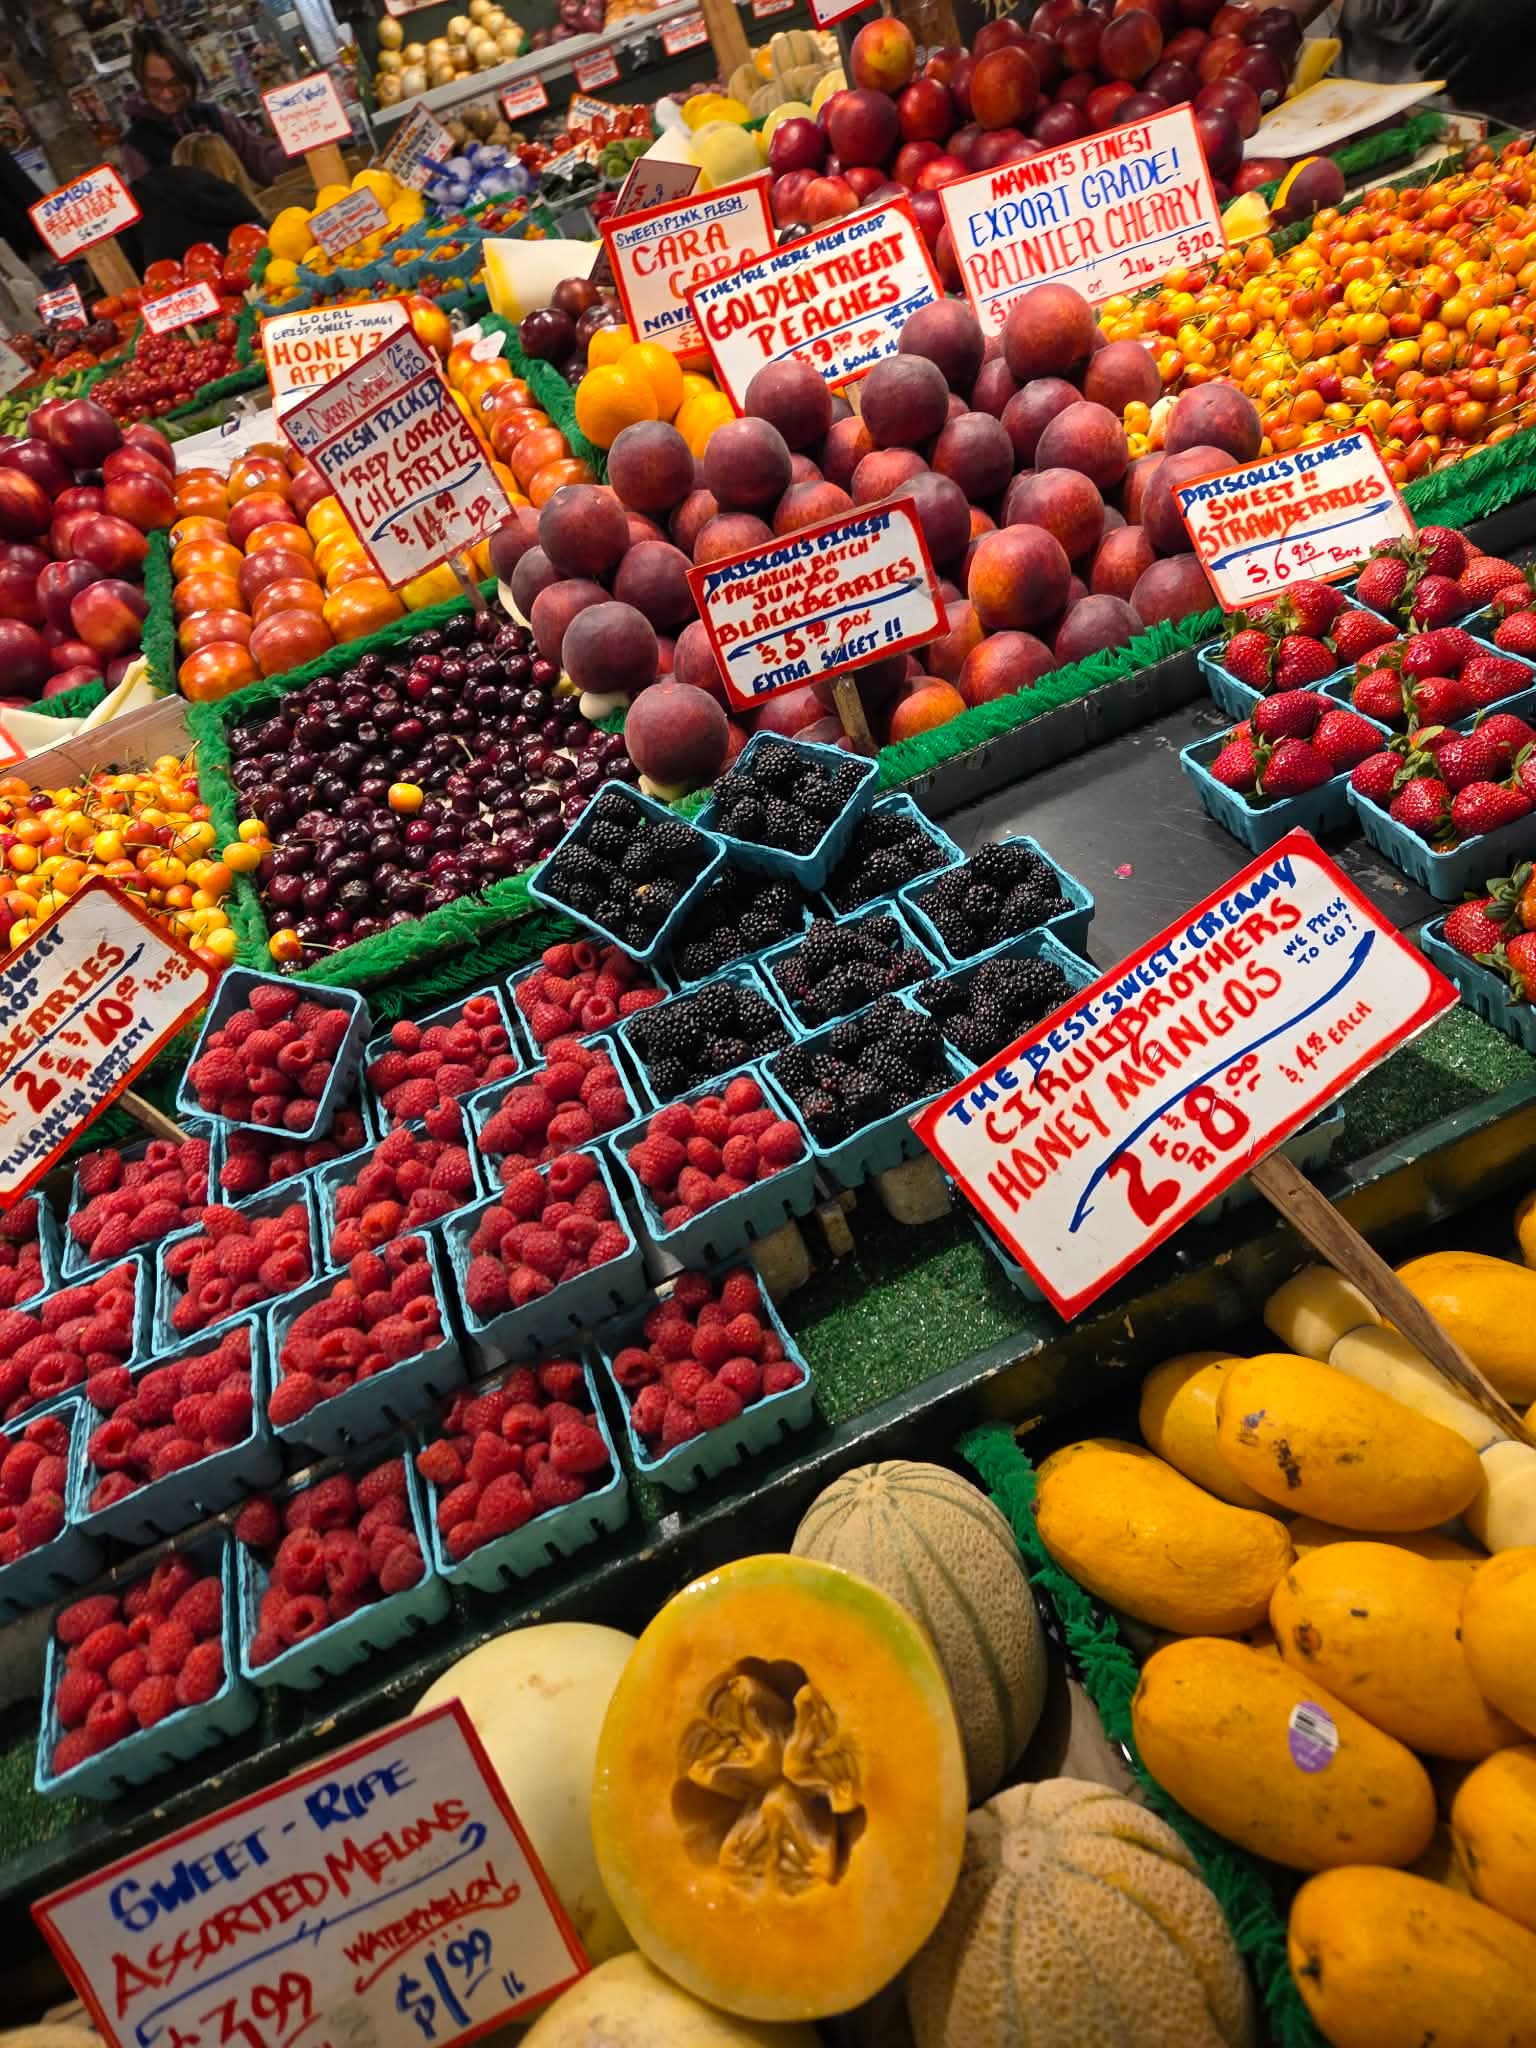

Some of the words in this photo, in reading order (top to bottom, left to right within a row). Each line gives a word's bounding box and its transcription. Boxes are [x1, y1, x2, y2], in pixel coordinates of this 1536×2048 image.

[967, 184, 1072, 248] EXPORT
[1080, 146, 1181, 209] GRADE!
[991, 152, 1076, 201] MANNY'S
[1080, 125, 1152, 169] FINEST
[703, 196, 743, 219] FLESH
[965, 215, 1103, 296] RAINIER
[1104, 178, 1204, 250] CHERRY
[1176, 231, 1214, 263] $20
[631, 222, 731, 277] CARA
[695, 264, 768, 304] THEY'RE
[847, 213, 886, 242] CROP
[705, 271, 818, 342] GOLDEN
[812, 232, 906, 288] TREAT
[299, 309, 353, 326] LOCAL
[747, 274, 901, 357] PEACHES
[320, 421, 378, 474] FRESH
[373, 377, 443, 433] PICKED
[1294, 434, 1364, 474] FINEST
[354, 424, 480, 529] CHERRIES
[1207, 480, 1295, 521] SWEET
[816, 510, 892, 551] FINEST
[1197, 474, 1386, 559] STRAWBERRIES
[714, 556, 917, 648] BLACKBERRIES
[752, 567, 840, 611] JUMBO
[752, 660, 811, 696] EXTRA
[820, 630, 880, 671] SWEET
[1282, 933, 1308, 958] WE
[1305, 896, 1348, 934] PACK
[1297, 946, 1320, 965] TO
[0, 977, 39, 1027] ROP
[0, 941, 126, 1081] BERRIES
[13, 1069, 63, 1115] 2
[946, 1065, 1019, 1127] THE
[987, 1090, 1111, 1214] HONEY
[1105, 960, 1282, 1111] MANGOS
[1107, 1151, 1182, 1227] 2
[1327, 1001, 1373, 1046] EACH
[108, 1825, 270, 1933] SWEET
[304, 1759, 417, 1832] RIPE
[111, 1871, 330, 2021] ASSORTED
[323, 1798, 470, 1900] MELONS
[342, 1860, 502, 1967] WATERMELON
